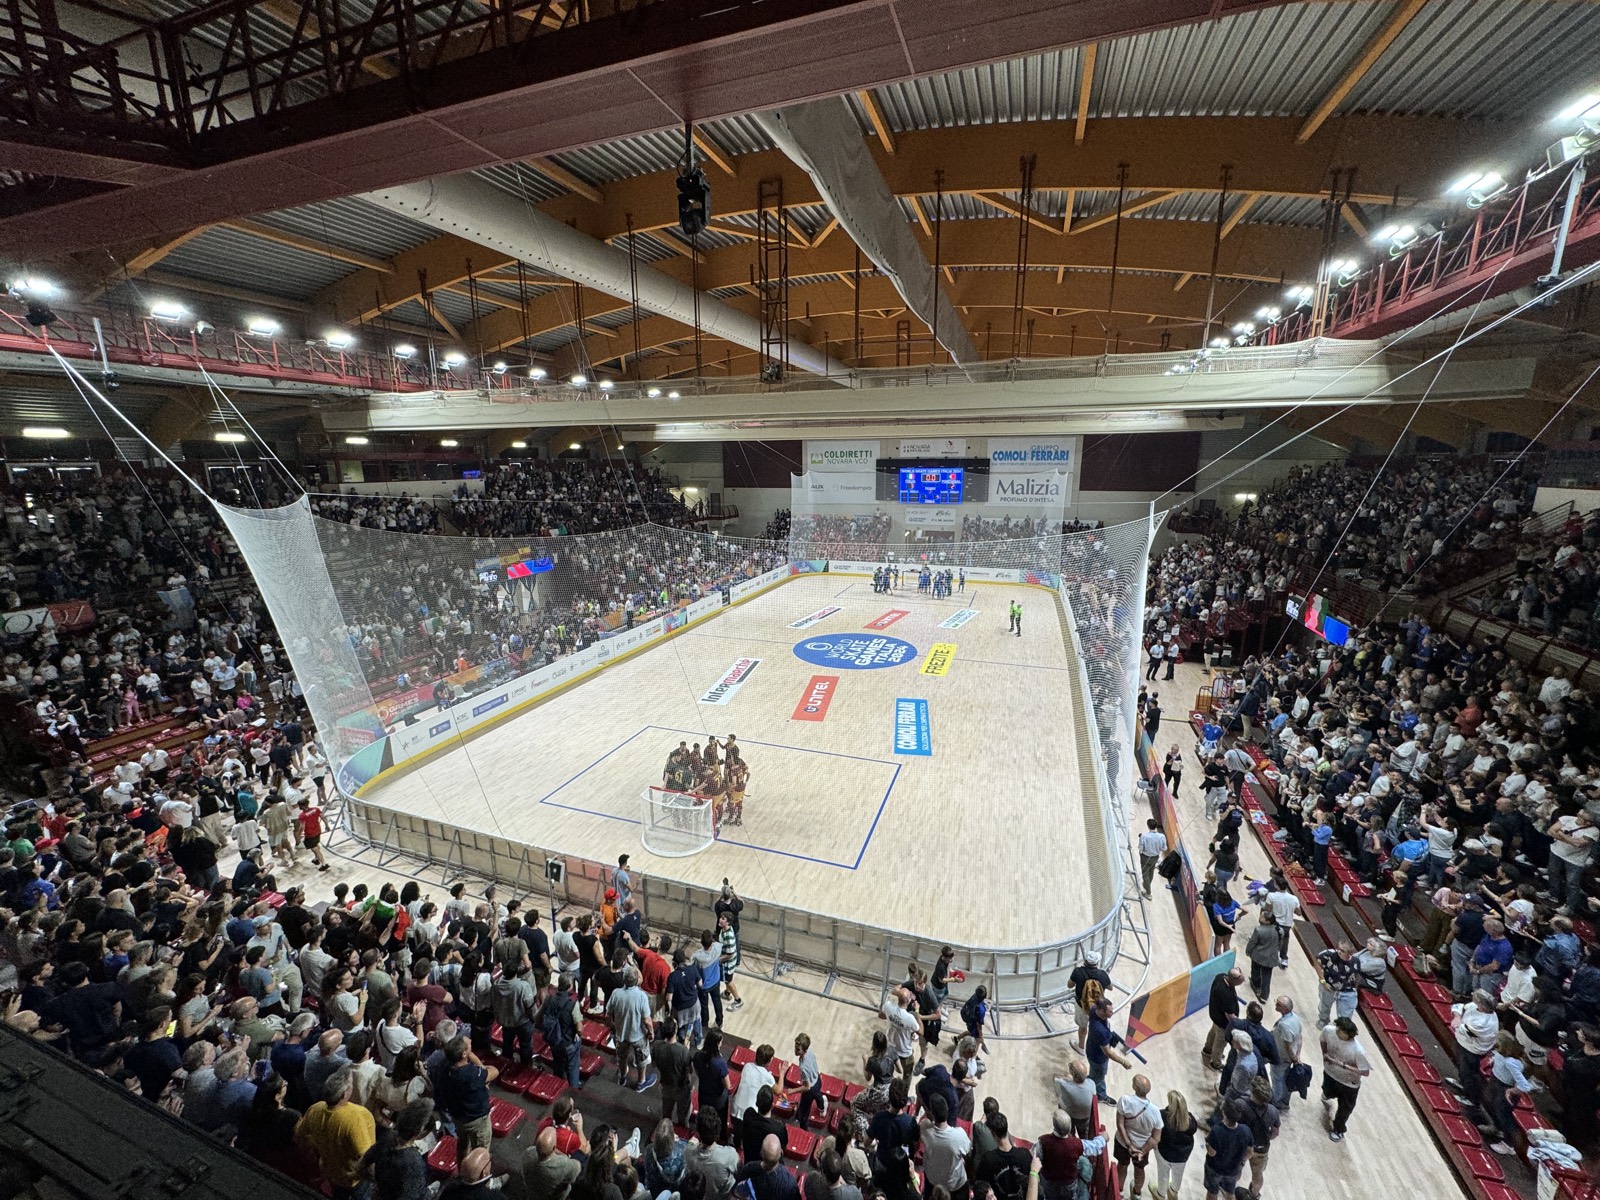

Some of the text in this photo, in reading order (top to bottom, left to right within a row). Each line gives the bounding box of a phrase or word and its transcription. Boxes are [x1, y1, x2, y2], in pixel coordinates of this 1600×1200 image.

[824, 450, 872, 458] COLDIRETTI
[992, 450, 1069, 461] COMOLI FERRARI
[996, 478, 1059, 495] Malizia
[825, 639, 853, 658] WORLD
[840, 640, 870, 660] SKATE
[855, 638, 888, 666] GAMES
[873, 643, 897, 663] ITALIA
[925, 649, 950, 674] FREZITE
[896, 701, 917, 750] COMOLI FERRARI
